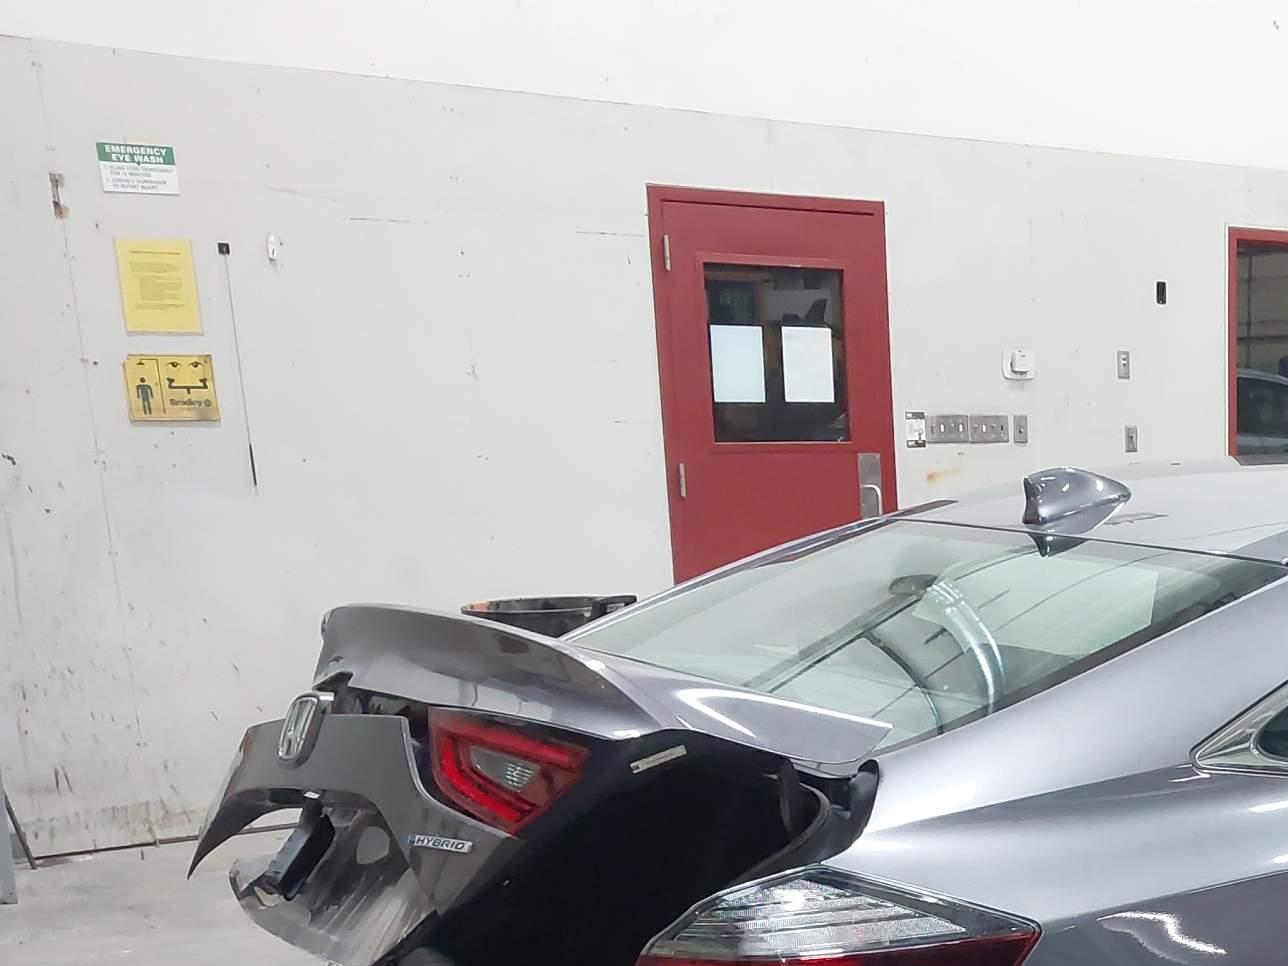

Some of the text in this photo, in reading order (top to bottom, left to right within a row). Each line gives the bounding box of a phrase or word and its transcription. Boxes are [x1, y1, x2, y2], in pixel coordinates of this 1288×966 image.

[104, 144, 167, 156] EMERGENCY
[111, 153, 164, 164] EYE WASH
[415, 836, 465, 850] HYBRID
